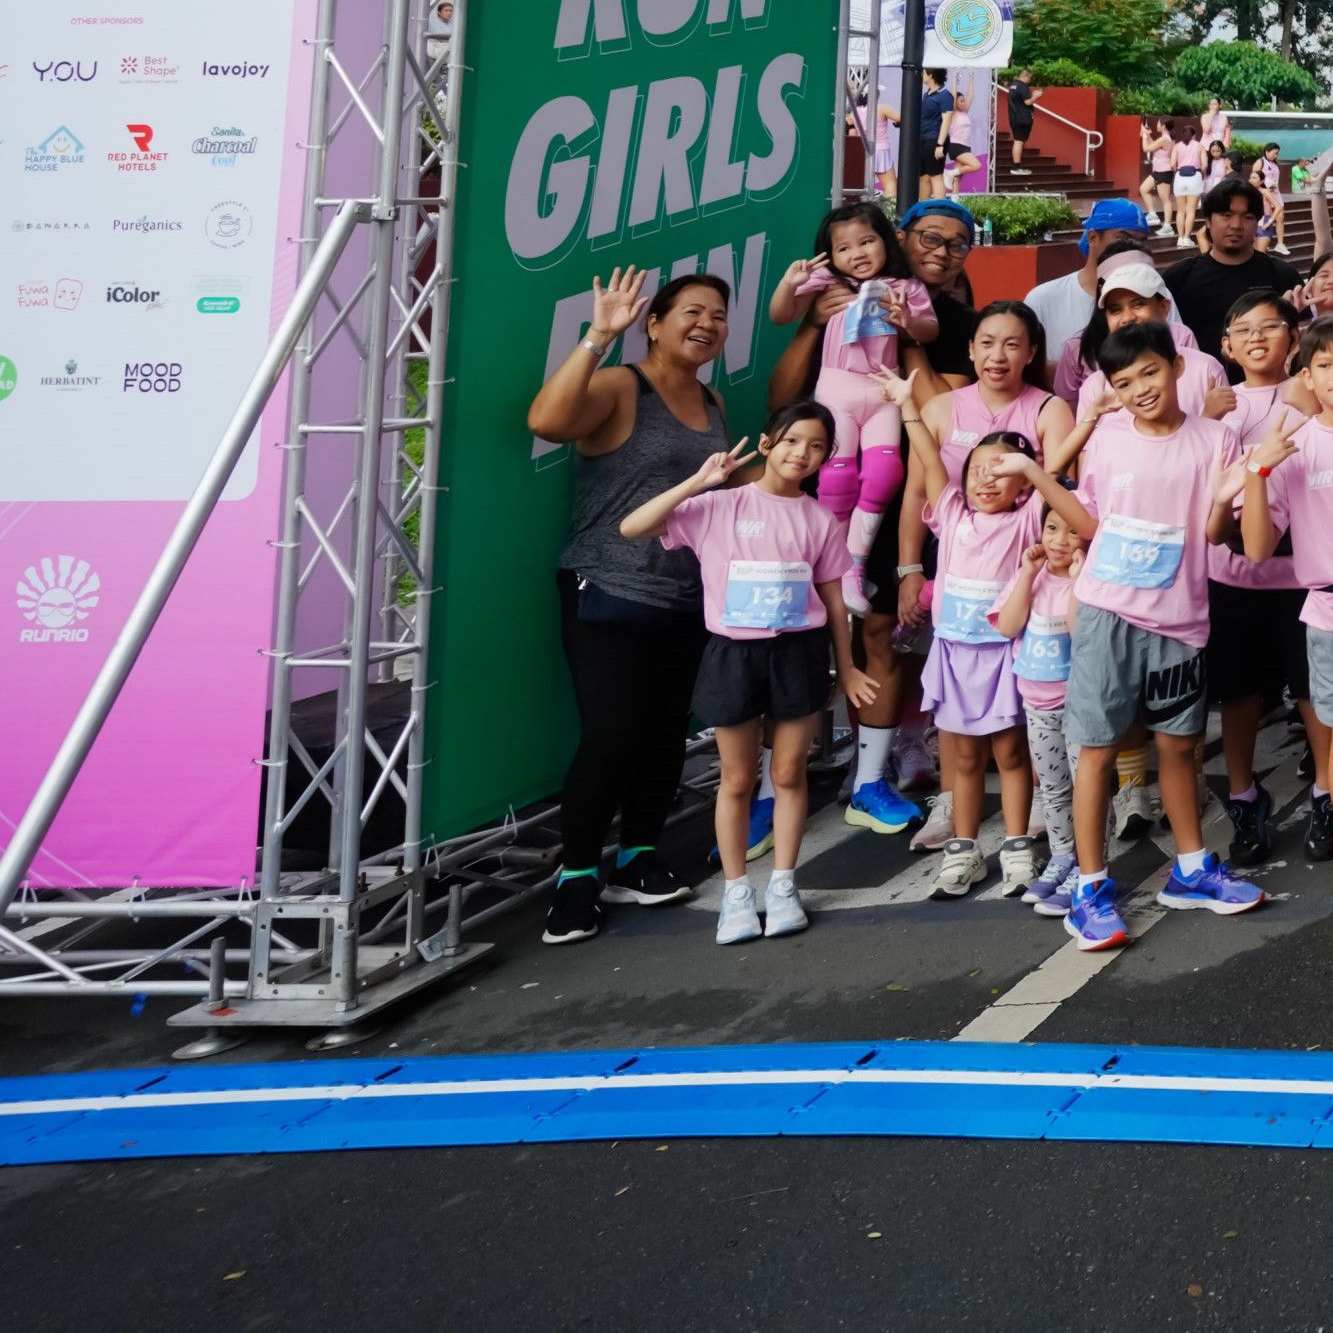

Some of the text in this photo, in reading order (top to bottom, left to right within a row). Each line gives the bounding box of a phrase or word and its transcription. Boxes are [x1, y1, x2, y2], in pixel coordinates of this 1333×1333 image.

[144, 56, 167, 65] Best
[144, 65, 177, 77] Shape
[202, 61, 270, 78] lavojoy
[192, 137, 258, 154] Charcoal
[60, 154, 84, 163] BLUE
[107, 152, 168, 161] RED PLANET
[504, 53, 809, 272] GIRLS
[118, 162, 157, 171] HOTELS
[113, 219, 183, 233] Pureganics
[107, 287, 160, 303] iColor
[124, 363, 183, 377] MOOD
[123, 378, 182, 393] FOOD
[752, 586, 793, 605] 134
[20, 629, 89, 643] RUNRIO
[1026, 638, 1061, 658] 163
